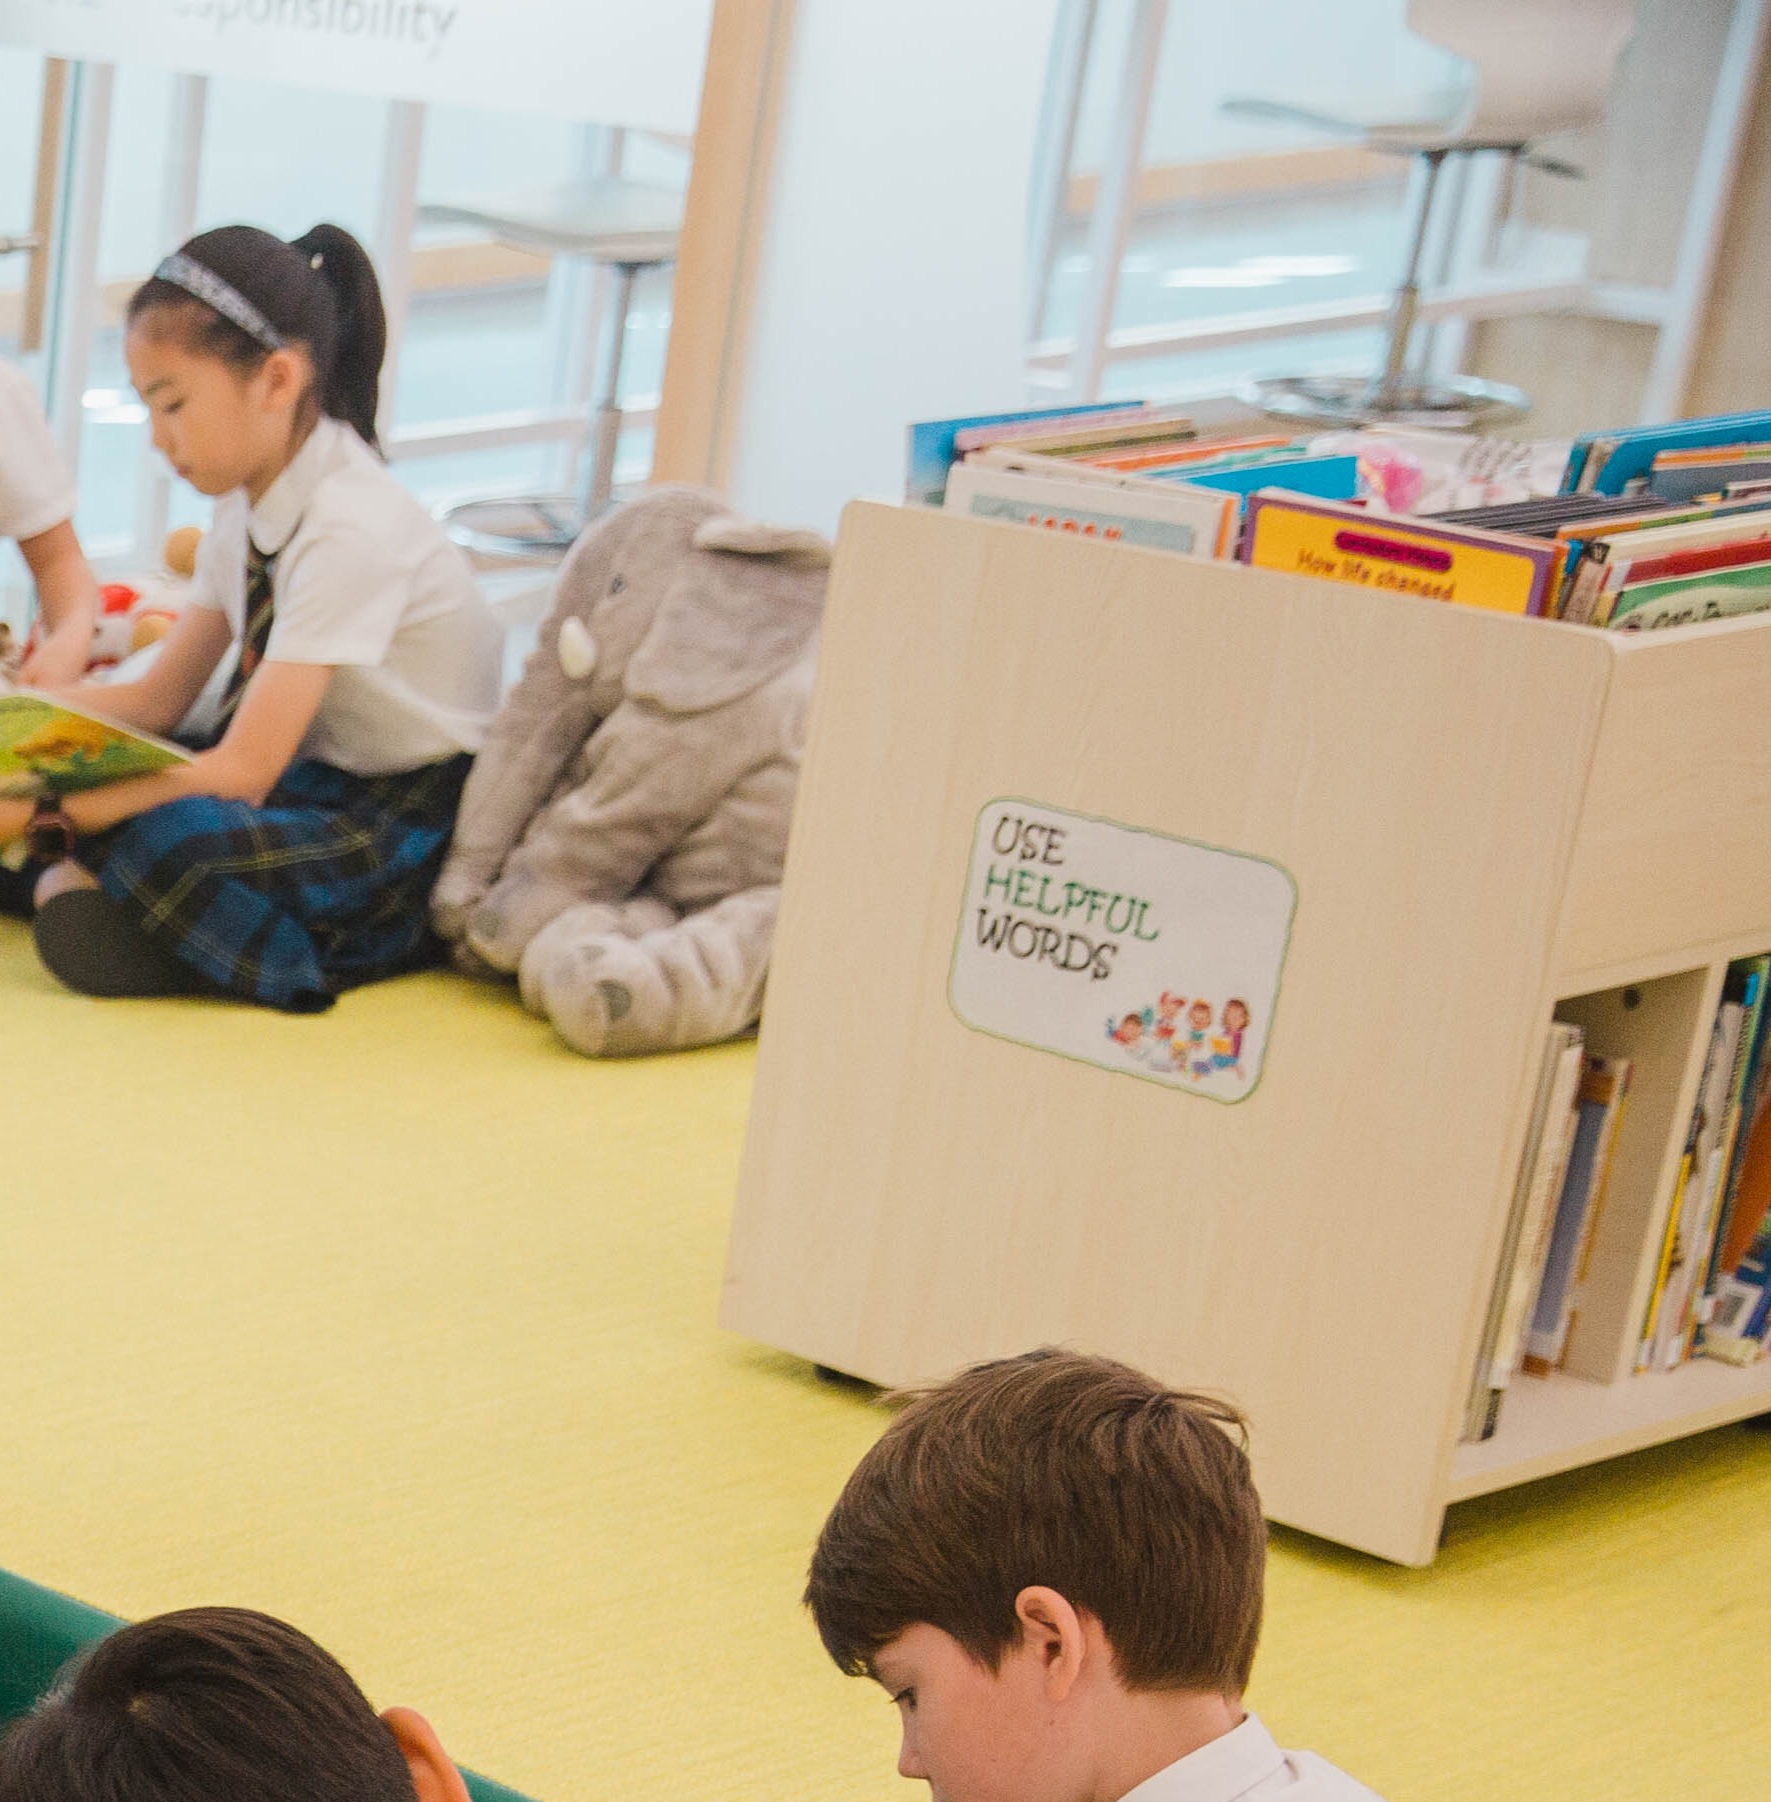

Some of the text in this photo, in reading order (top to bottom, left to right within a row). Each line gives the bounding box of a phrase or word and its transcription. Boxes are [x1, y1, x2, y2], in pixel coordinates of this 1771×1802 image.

[1298, 549, 1336, 572] How
[993, 815, 1068, 867] USE
[983, 864, 1160, 942] HELPFUL
[977, 907, 1119, 982] WORDS
